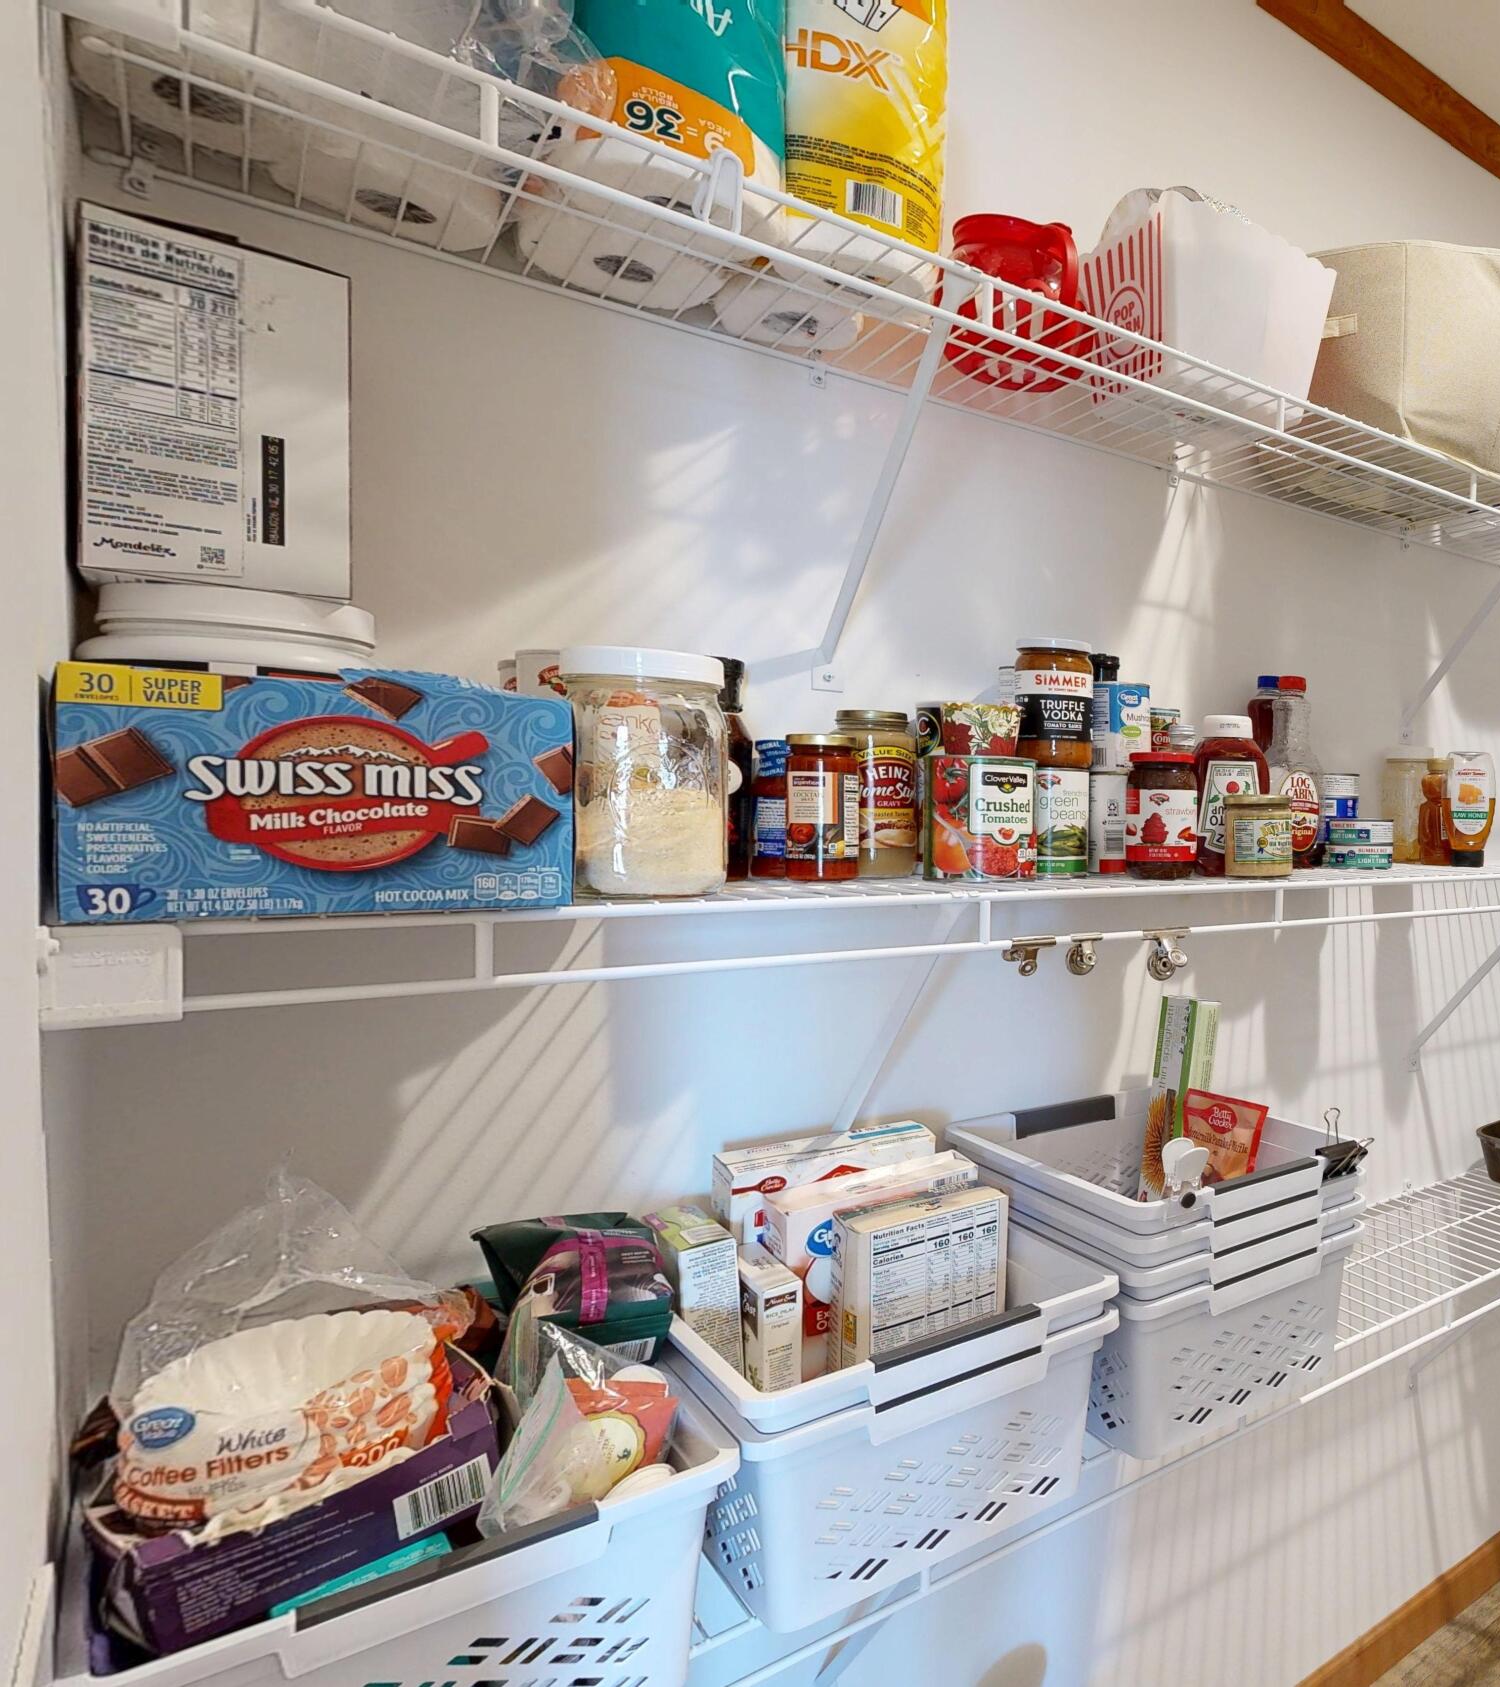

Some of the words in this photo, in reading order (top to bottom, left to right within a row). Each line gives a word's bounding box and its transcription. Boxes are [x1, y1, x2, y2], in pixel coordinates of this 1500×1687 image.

[786, 28, 889, 91] HDX
[632, 91, 678, 110] REGULAR
[624, 99, 685, 143] 36
[698, 118, 732, 137] MEGA
[1114, 301, 1135, 321] POP
[79, 672, 113, 693] 30
[143, 677, 201, 692] SUPER
[1034, 673, 1087, 689] SIMMER
[143, 689, 200, 705] VALUE
[1039, 699, 1085, 712] TRUFFLE
[1042, 710, 1083, 722] VODKA
[858, 748, 895, 759] VALUE
[866, 766, 910, 781] HEINZ
[985, 774, 1008, 784] Clover
[1008, 775, 1026, 785] Valley
[1290, 776, 1310, 788] LOG
[1285, 787, 1314, 800] CABIN
[975, 798, 1030, 813] Crushed
[1040, 796, 1078, 809] green
[249, 811, 306, 831] Milk
[309, 802, 429, 828] Chocolate
[1049, 809, 1087, 820] beans
[1164, 807, 1197, 816] strawbe
[980, 814, 1028, 824] Tomatoes
[77, 823, 93, 832] NO
[323, 822, 363, 835] FLAVOR
[86, 833, 156, 842] SWEETENERS
[86, 843, 168, 853] PRESERVATIVES
[86, 854, 134, 863] FLAVORS
[86, 864, 128, 874] COLORS
[477, 877, 495, 889] 160
[220, 887, 268, 899] ENVELOPES
[375, 890, 401, 903] HOT
[403, 889, 444, 902] COCOA
[445, 889, 469, 900] MIX
[87, 887, 131, 915] 30
[166, 901, 184, 912] NET
[186, 901, 200, 912] WT
[1164, 1005, 1175, 1056] spaghetti
[1213, 1107, 1232, 1122] Betty
[1209, 1115, 1232, 1129] Crocker
[873, 1228, 904, 1241] Nutrition
[906, 1222, 925, 1233] Facts
[958, 1231, 974, 1243] 160
[982, 1225, 997, 1235] 160
[933, 1238, 950, 1250] 160
[873, 1252, 904, 1266] Calories
[134, 1416, 184, 1432] Great
[216, 1428, 287, 1455] White
[351, 1437, 399, 1467] 200
[127, 1466, 197, 1487] Coffee
[206, 1446, 290, 1479] Filters
